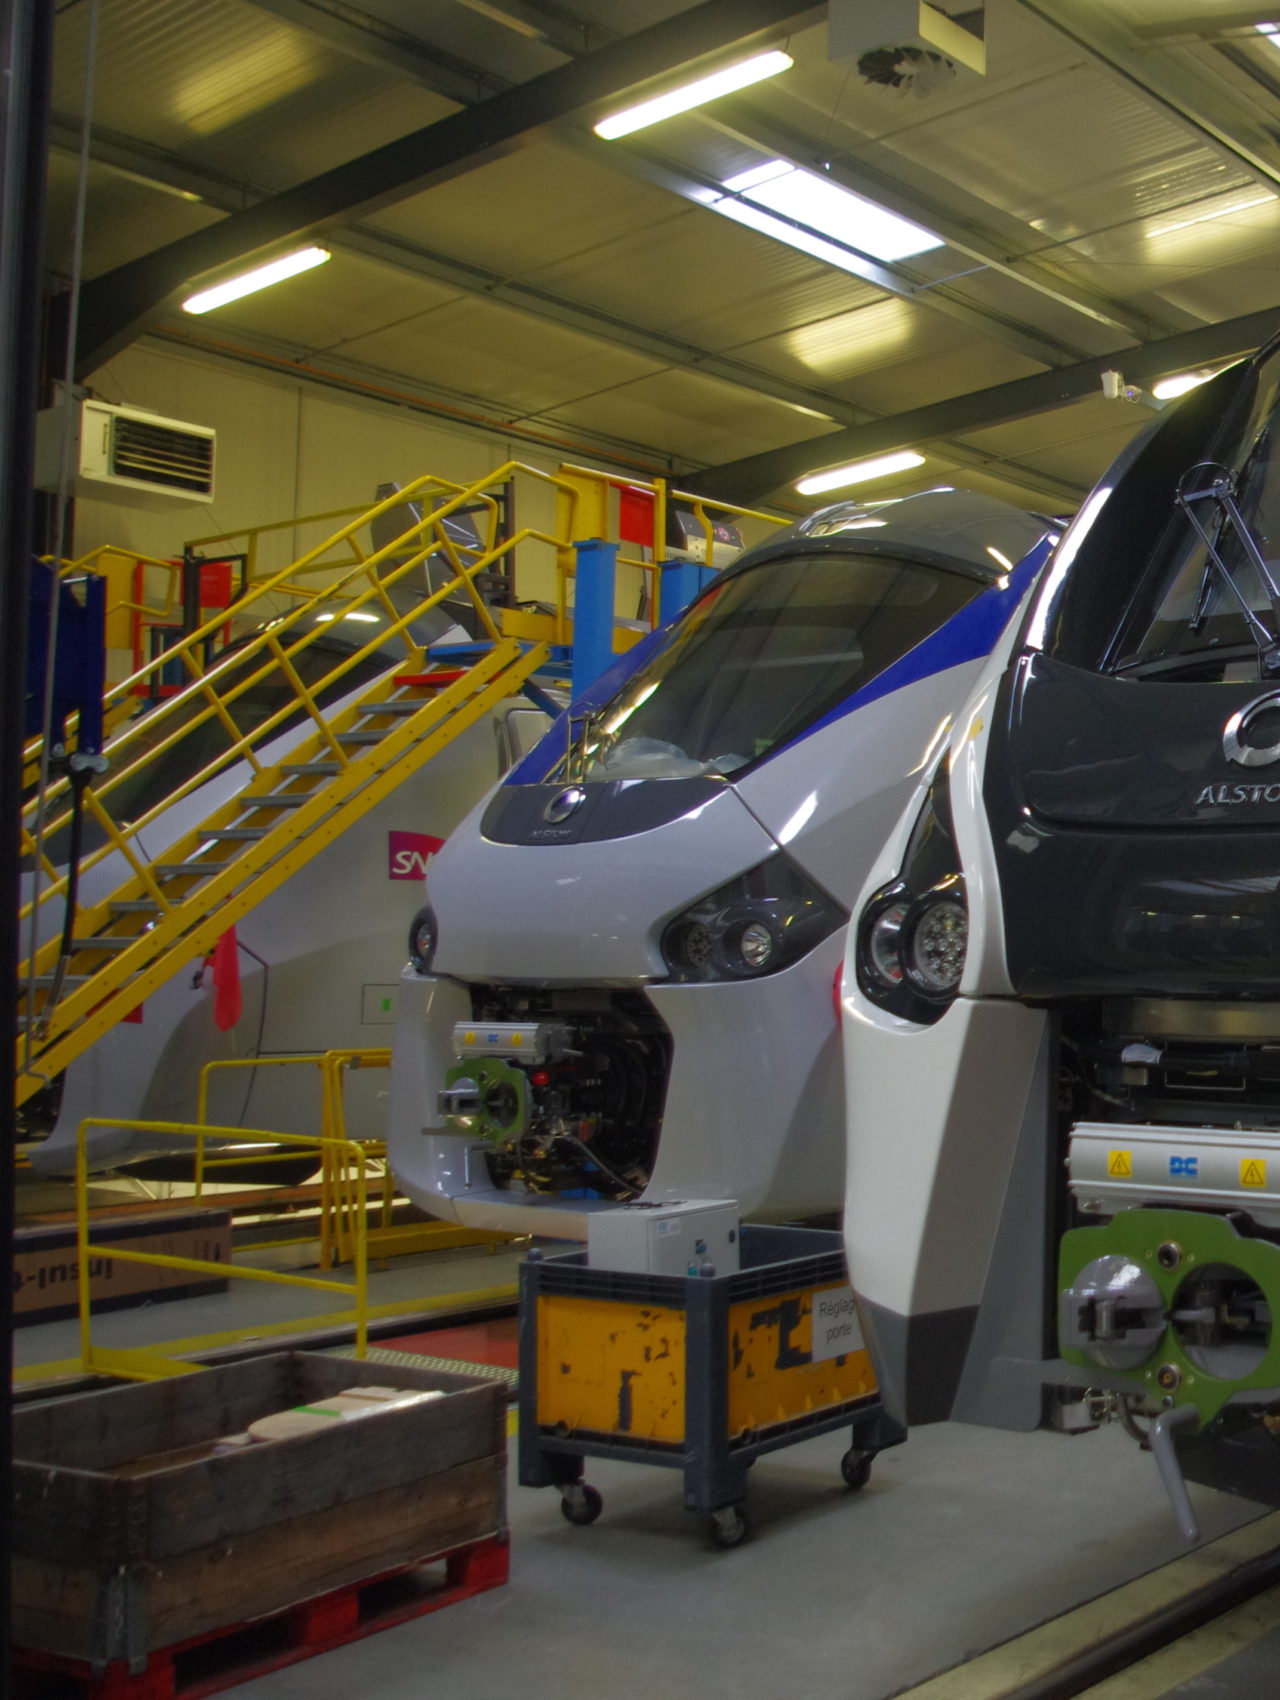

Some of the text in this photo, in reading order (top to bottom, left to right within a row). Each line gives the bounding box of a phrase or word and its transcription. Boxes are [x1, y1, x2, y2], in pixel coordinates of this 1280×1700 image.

[392, 850, 433, 874] SN
[819, 1299, 855, 1319] Réglag
[826, 1323, 853, 1344] porte
